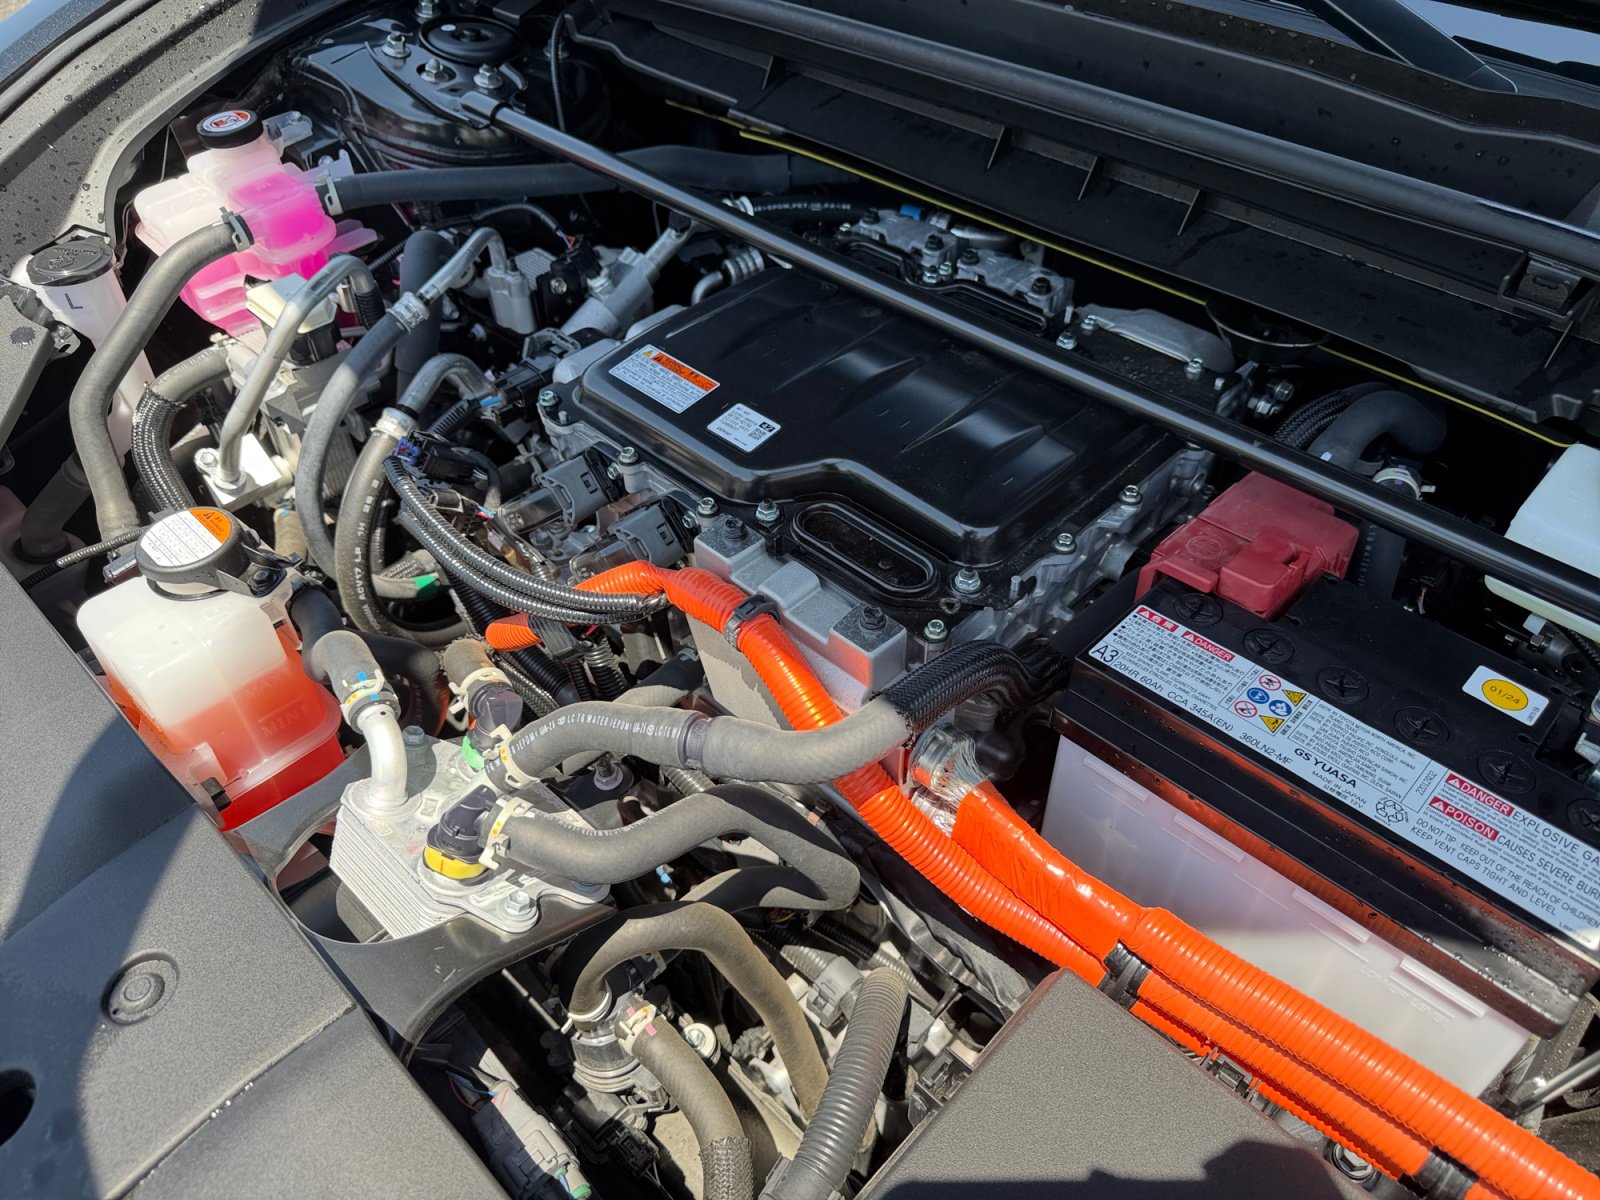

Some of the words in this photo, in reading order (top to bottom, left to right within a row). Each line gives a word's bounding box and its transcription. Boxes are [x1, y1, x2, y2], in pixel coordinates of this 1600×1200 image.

[65, 293, 84, 310] L
[760, 422, 776, 432] 42
[354, 547, 362, 562] LP
[1092, 643, 1119, 662] A3
[1193, 637, 1232, 660] DANGER
[1490, 686, 1520, 704] 01/24
[586, 714, 608, 727] WATER
[1114, 661, 1139, 677] 20HR
[1139, 675, 1164, 691] 60Ah
[1166, 690, 1189, 706] CCA
[1189, 703, 1233, 731] 345A(EN)
[1239, 732, 1292, 765] 360LN2-MF
[1328, 726, 1345, 737] TOYOTA
[1338, 714, 1355, 725] TOYOTA
[1354, 724, 1370, 734] MOTOR
[1370, 732, 1385, 742] NORTH
[1322, 734, 1339, 744] TOYOTA
[1338, 749, 1360, 762] AMERICAN
[1293, 747, 1312, 760] GS
[1310, 757, 1358, 787] YUASA
[1311, 771, 1332, 784] MADE
[1342, 788, 1366, 804] JAPAN
[1350, 799, 1362, 808] 12V
[1459, 782, 1511, 814] DANGER
[1511, 811, 1580, 853] EXPLOSIVE
[1581, 850, 1600, 866] GA
[1444, 806, 1494, 837] POISON
[1496, 835, 1536, 861] CAUSES
[1535, 857, 1576, 884] SEVERE
[1410, 826, 1432, 841] KEEP
[1432, 838, 1455, 854] VENT
[1455, 852, 1481, 870] CAPS
[1481, 867, 1507, 885] TIGHT
[1507, 882, 1529, 898] AND
[1529, 895, 1558, 915] LEVEL
[1416, 818, 1429, 828] DO
[1428, 824, 1445, 837] NOT
[1459, 842, 1479, 857] KEEP
[1478, 854, 1494, 866] OUT
[1494, 863, 1507, 873] OF
[1506, 870, 1522, 882] THE
[1523, 879, 1549, 898] REACH
[1548, 894, 1561, 905] OF
[1560, 901, 1600, 928] CHILDREN
